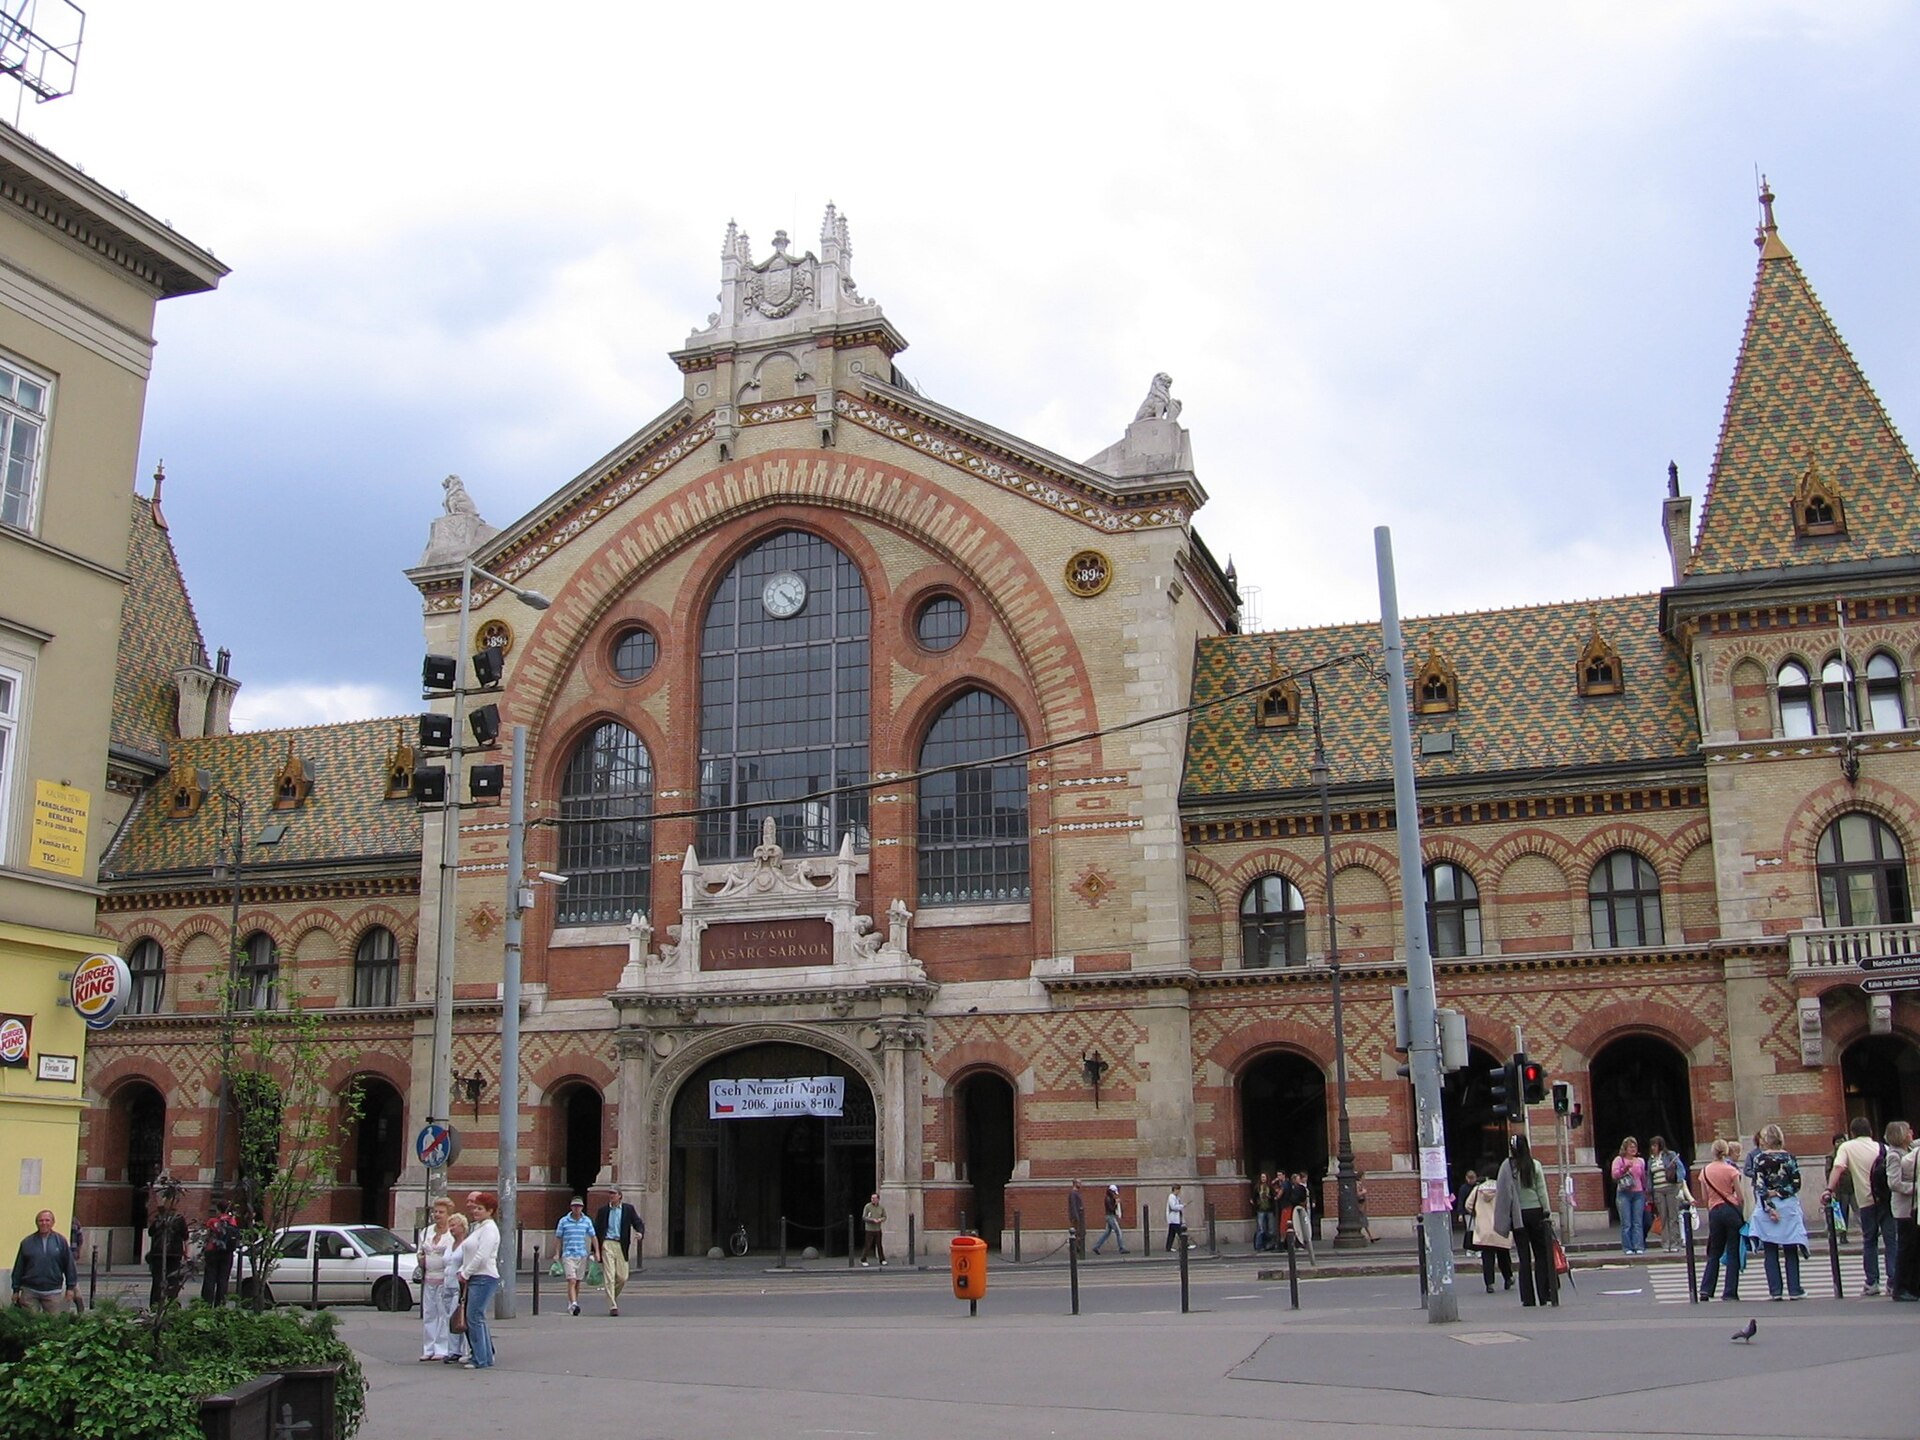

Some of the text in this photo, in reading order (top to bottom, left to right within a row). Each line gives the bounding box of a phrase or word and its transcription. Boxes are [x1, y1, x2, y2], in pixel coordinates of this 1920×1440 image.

[1872, 958, 1902, 967] National
[75, 965, 115, 989] BURGER
[75, 976, 115, 1006] KING
[1, 1027, 23, 1040] BURGER
[0, 1035, 24, 1051] KING
[714, 1082, 837, 1097] Cseh Nemzeti Napok
[741, 1098, 838, 1112] 2006. június 8-10.
